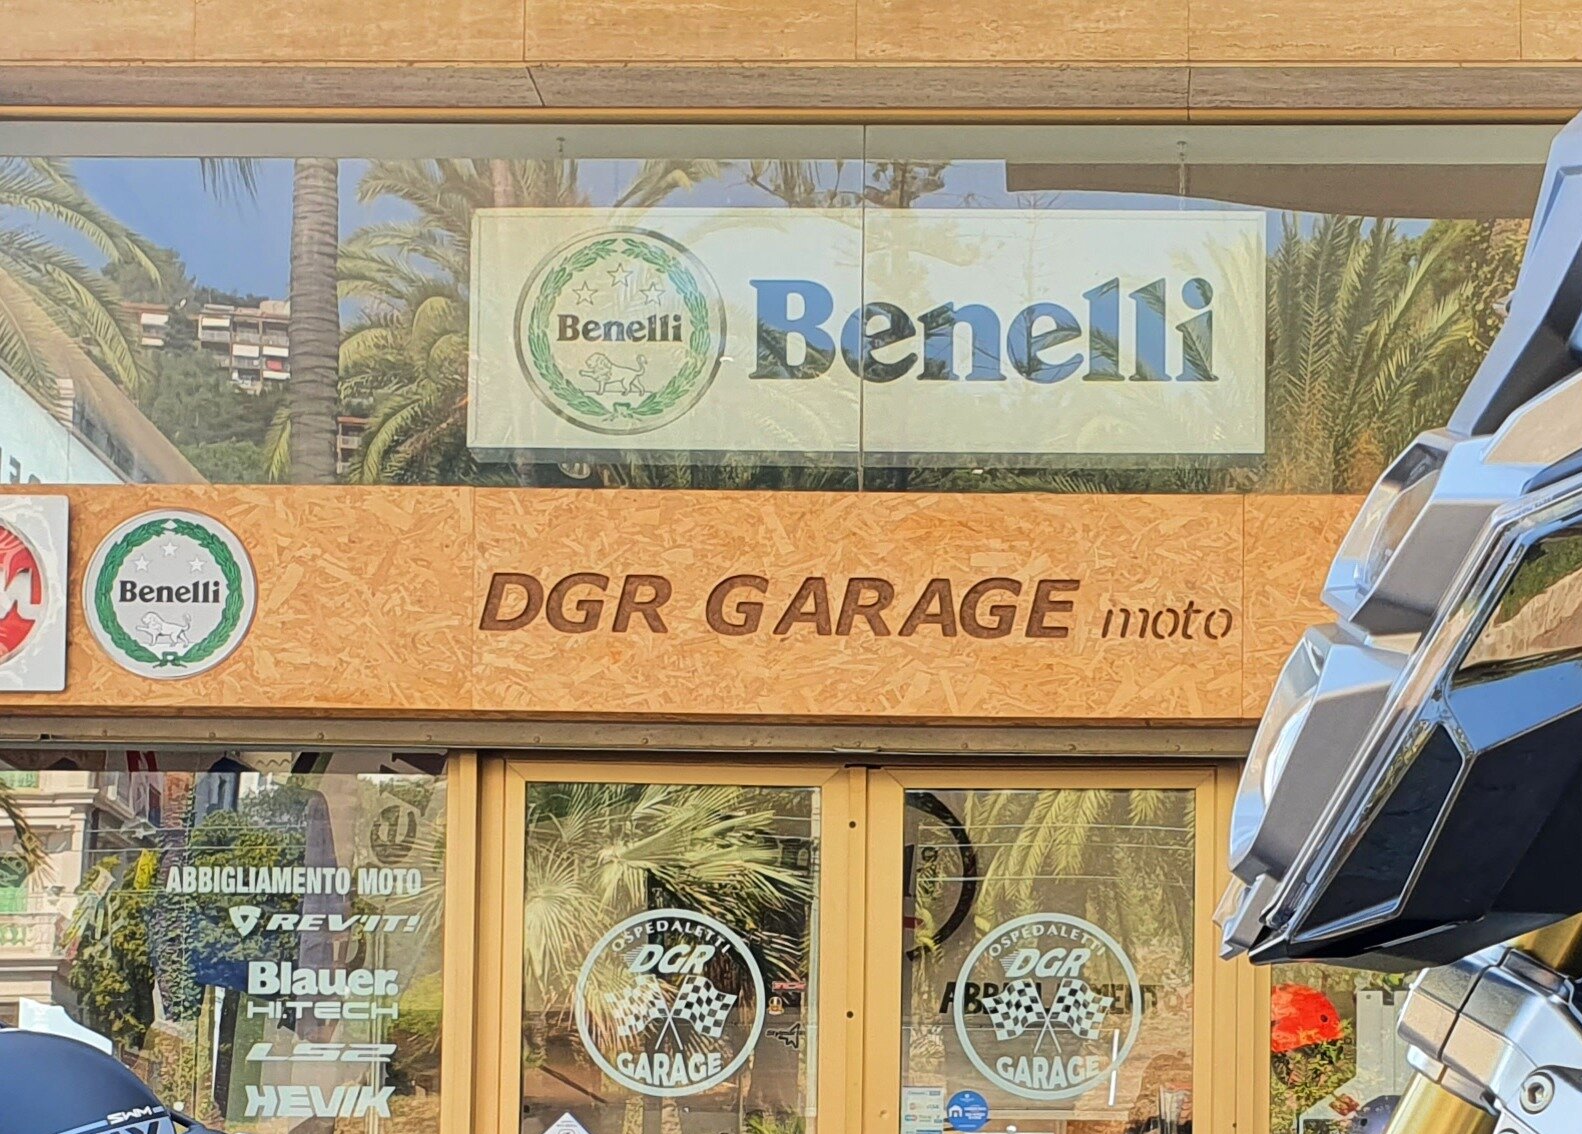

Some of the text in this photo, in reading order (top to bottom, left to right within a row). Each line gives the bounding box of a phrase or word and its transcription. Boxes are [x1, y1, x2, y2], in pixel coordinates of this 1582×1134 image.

[556, 312, 683, 344] Benelli
[748, 277, 1219, 383] Benelli
[119, 580, 220, 604] Benelli
[479, 571, 1233, 641] DGR GARAGE moto
[166, 866, 422, 896] ABBIGLIAMENTO MOTO
[611, 920, 731, 954] OSPEDALETTI
[988, 924, 1106, 958] OSPEDALETTI
[628, 943, 717, 974] DGR
[1004, 947, 1092, 978] DGR
[246, 1043, 398, 1062] LS2
[616, 1052, 723, 1087] GARAGE
[995, 1055, 1101, 1090] GARAGE
[244, 1085, 396, 1118] HEVIK
